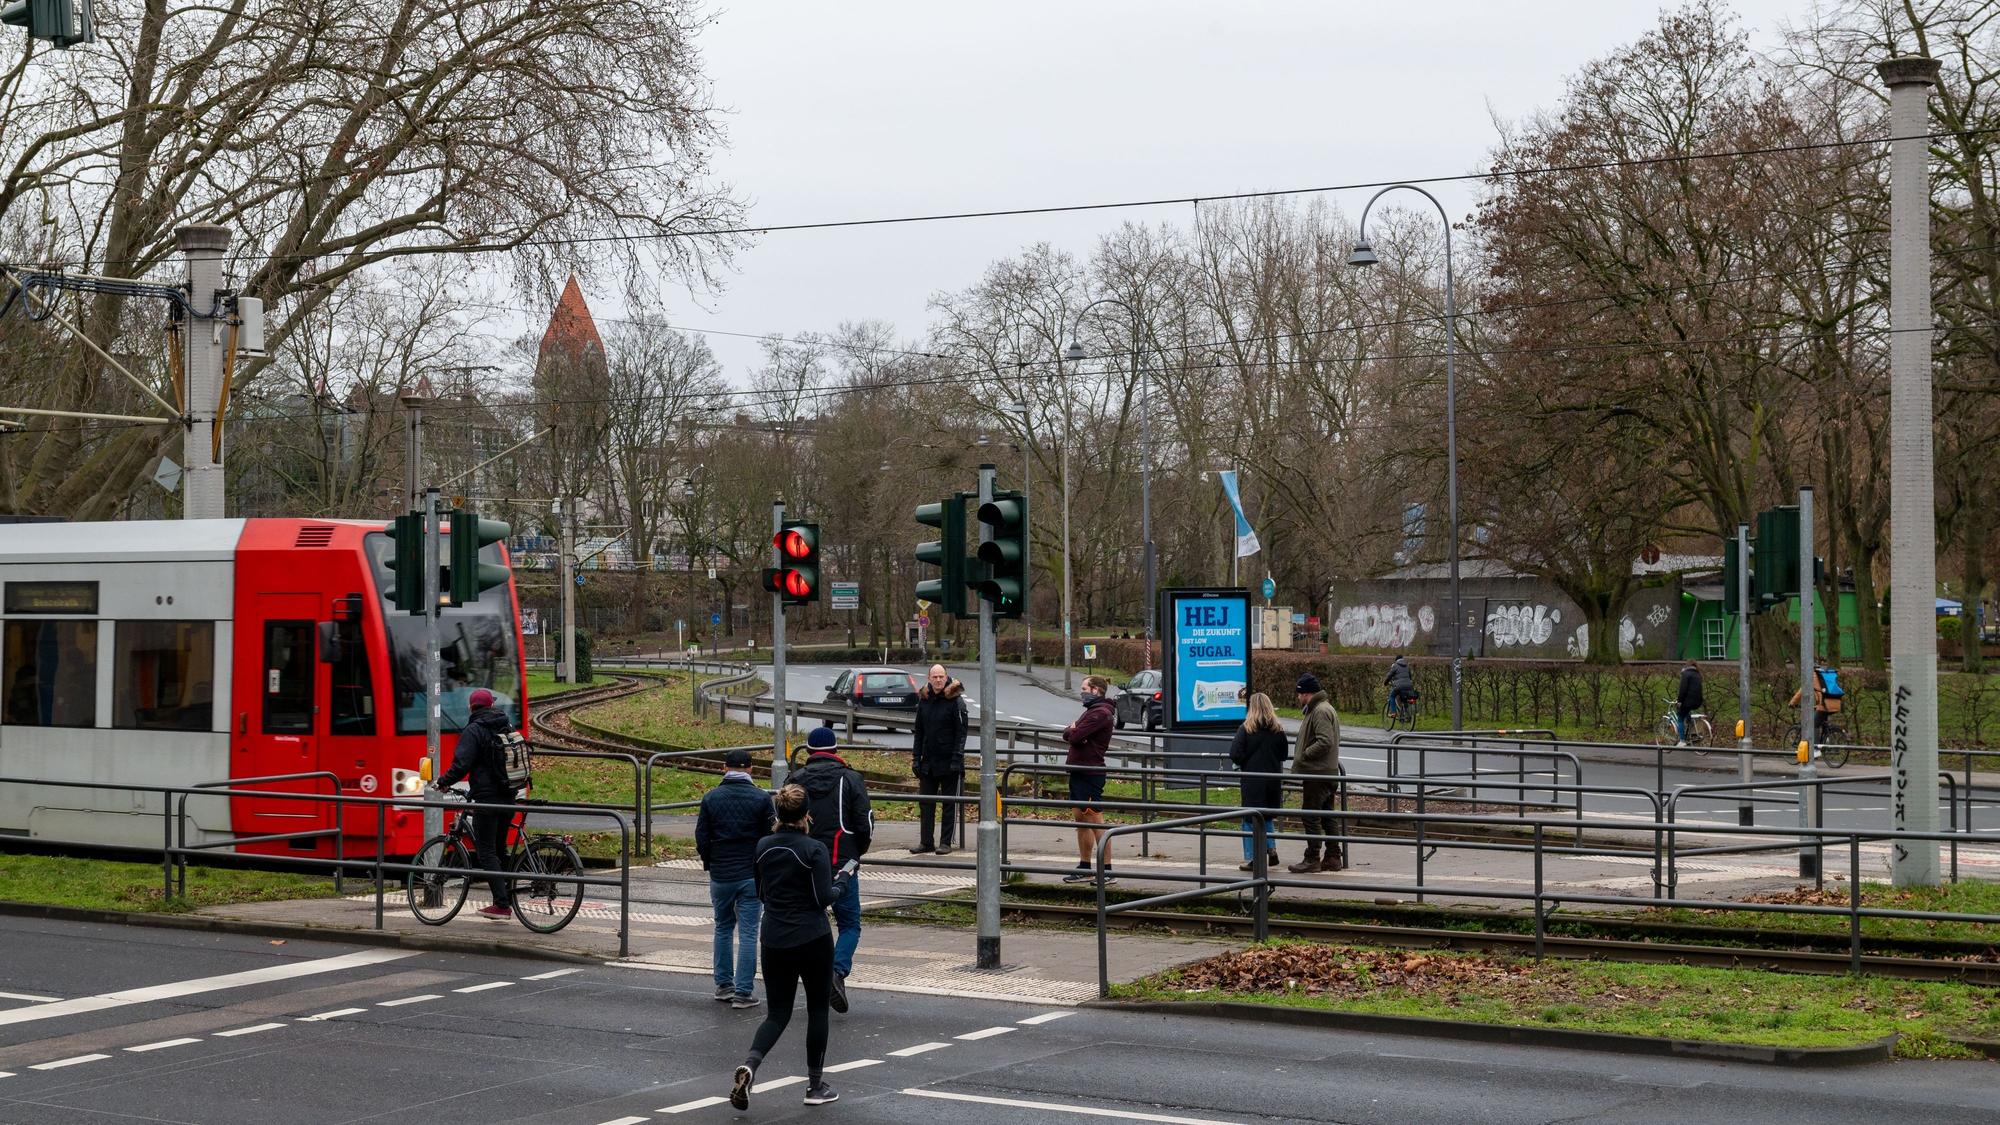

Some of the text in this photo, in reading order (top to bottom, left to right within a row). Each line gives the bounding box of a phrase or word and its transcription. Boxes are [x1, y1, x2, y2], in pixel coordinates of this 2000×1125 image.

[1192, 628, 1241, 636] DIE ZUKUNFT
[1189, 645, 1235, 658] SUGAR.
